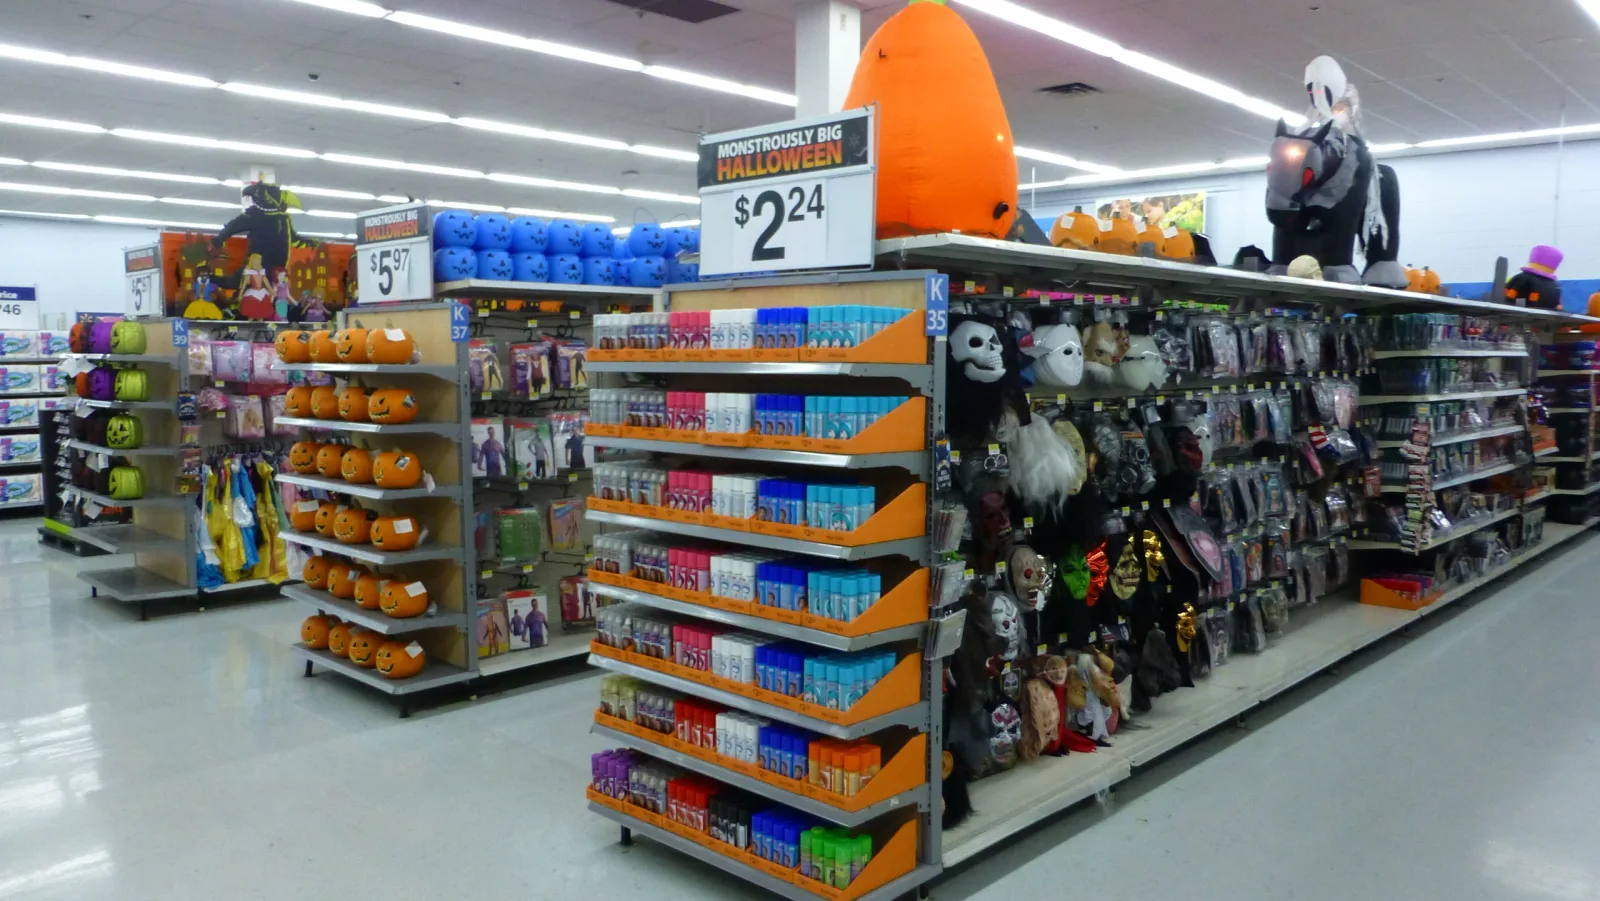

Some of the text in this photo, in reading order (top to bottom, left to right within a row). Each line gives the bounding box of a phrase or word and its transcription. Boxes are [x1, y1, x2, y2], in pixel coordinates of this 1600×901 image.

[718, 124, 842, 159] MONSTROUSLY BIG
[717, 140, 843, 181] HALLOWEEN
[364, 220, 418, 242] HALLOWEEN
[931, 277, 944, 301] K
[453, 306, 465, 320] K
[927, 309, 946, 331] 35
[175, 320, 185, 332] K
[452, 326, 468, 339] 37
[173, 334, 187, 345] 39
